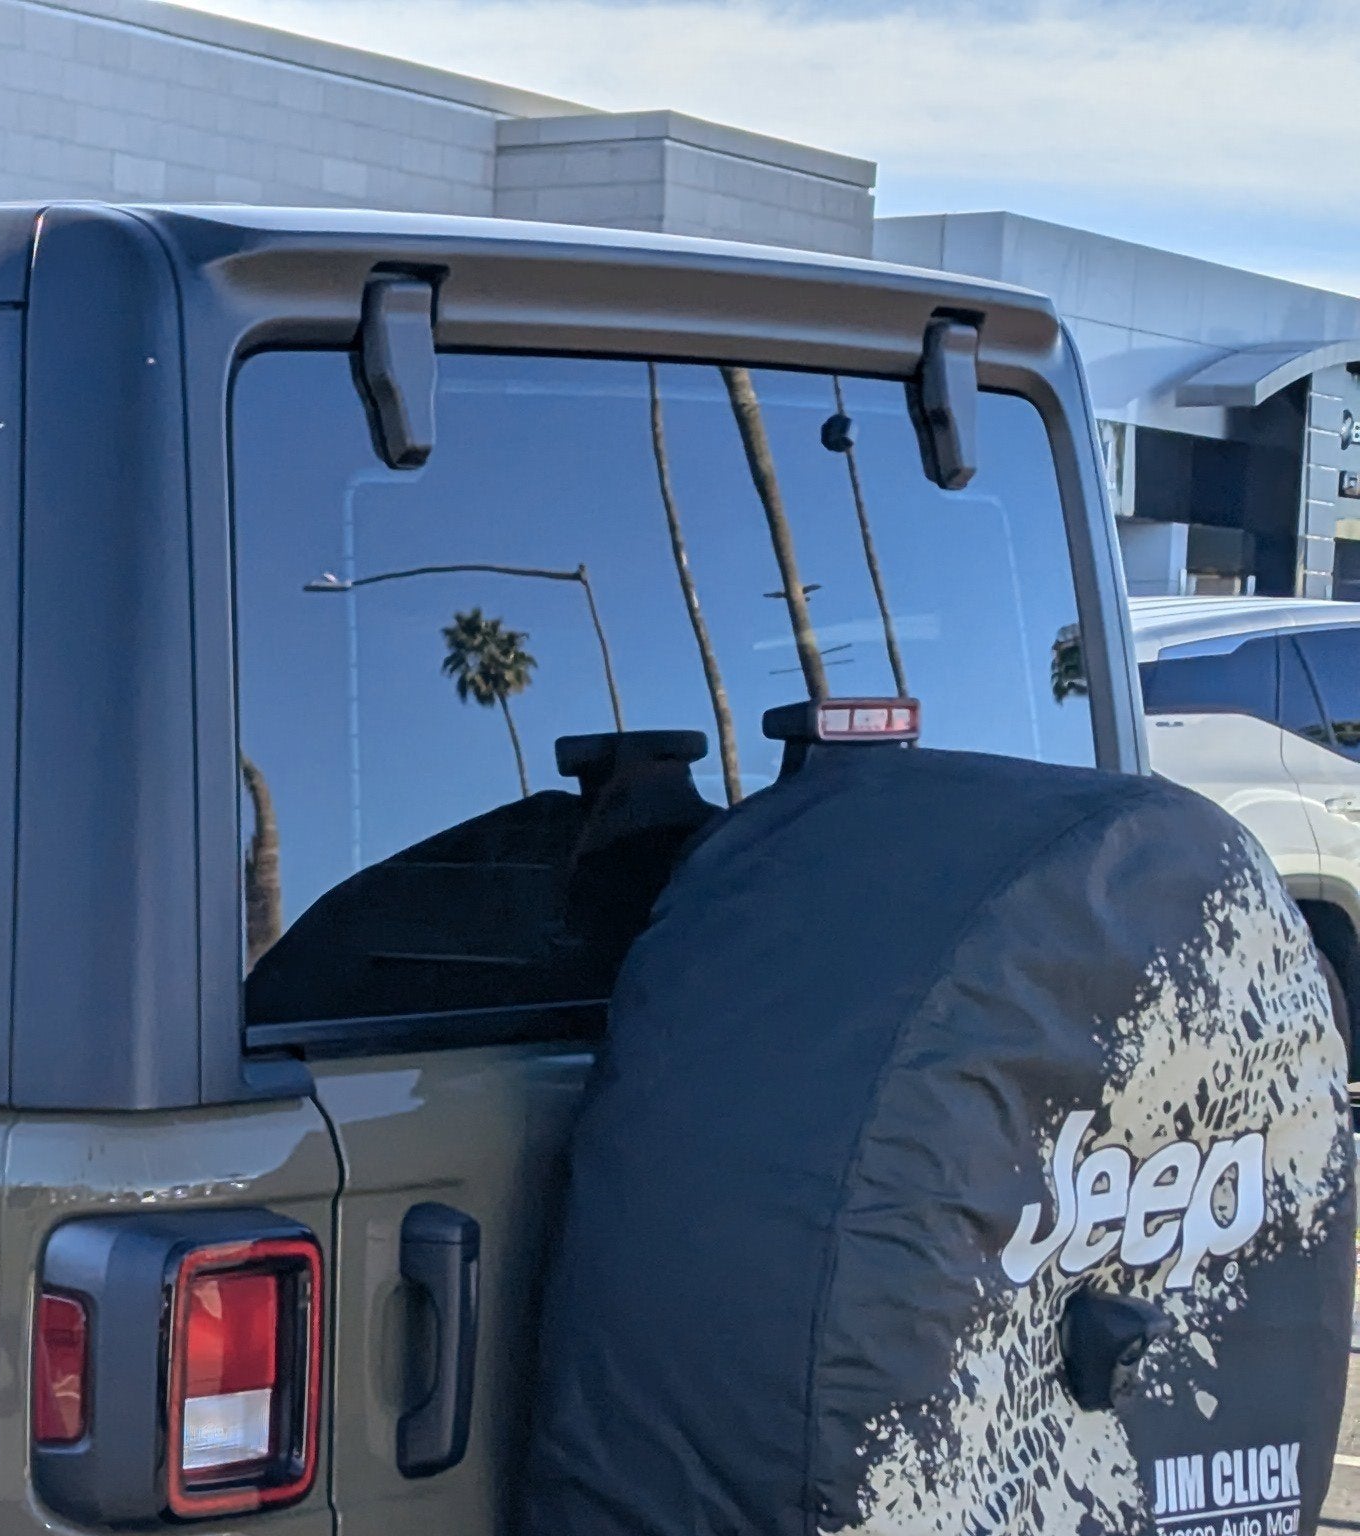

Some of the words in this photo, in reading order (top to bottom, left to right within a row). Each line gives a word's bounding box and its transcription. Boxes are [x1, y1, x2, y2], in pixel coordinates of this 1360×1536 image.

[1002, 1110, 1265, 1289] Jeep
[1155, 1455, 1206, 1515] JIM
[1211, 1442, 1301, 1507] CLICK
[1266, 1508, 1300, 1536] Mall
